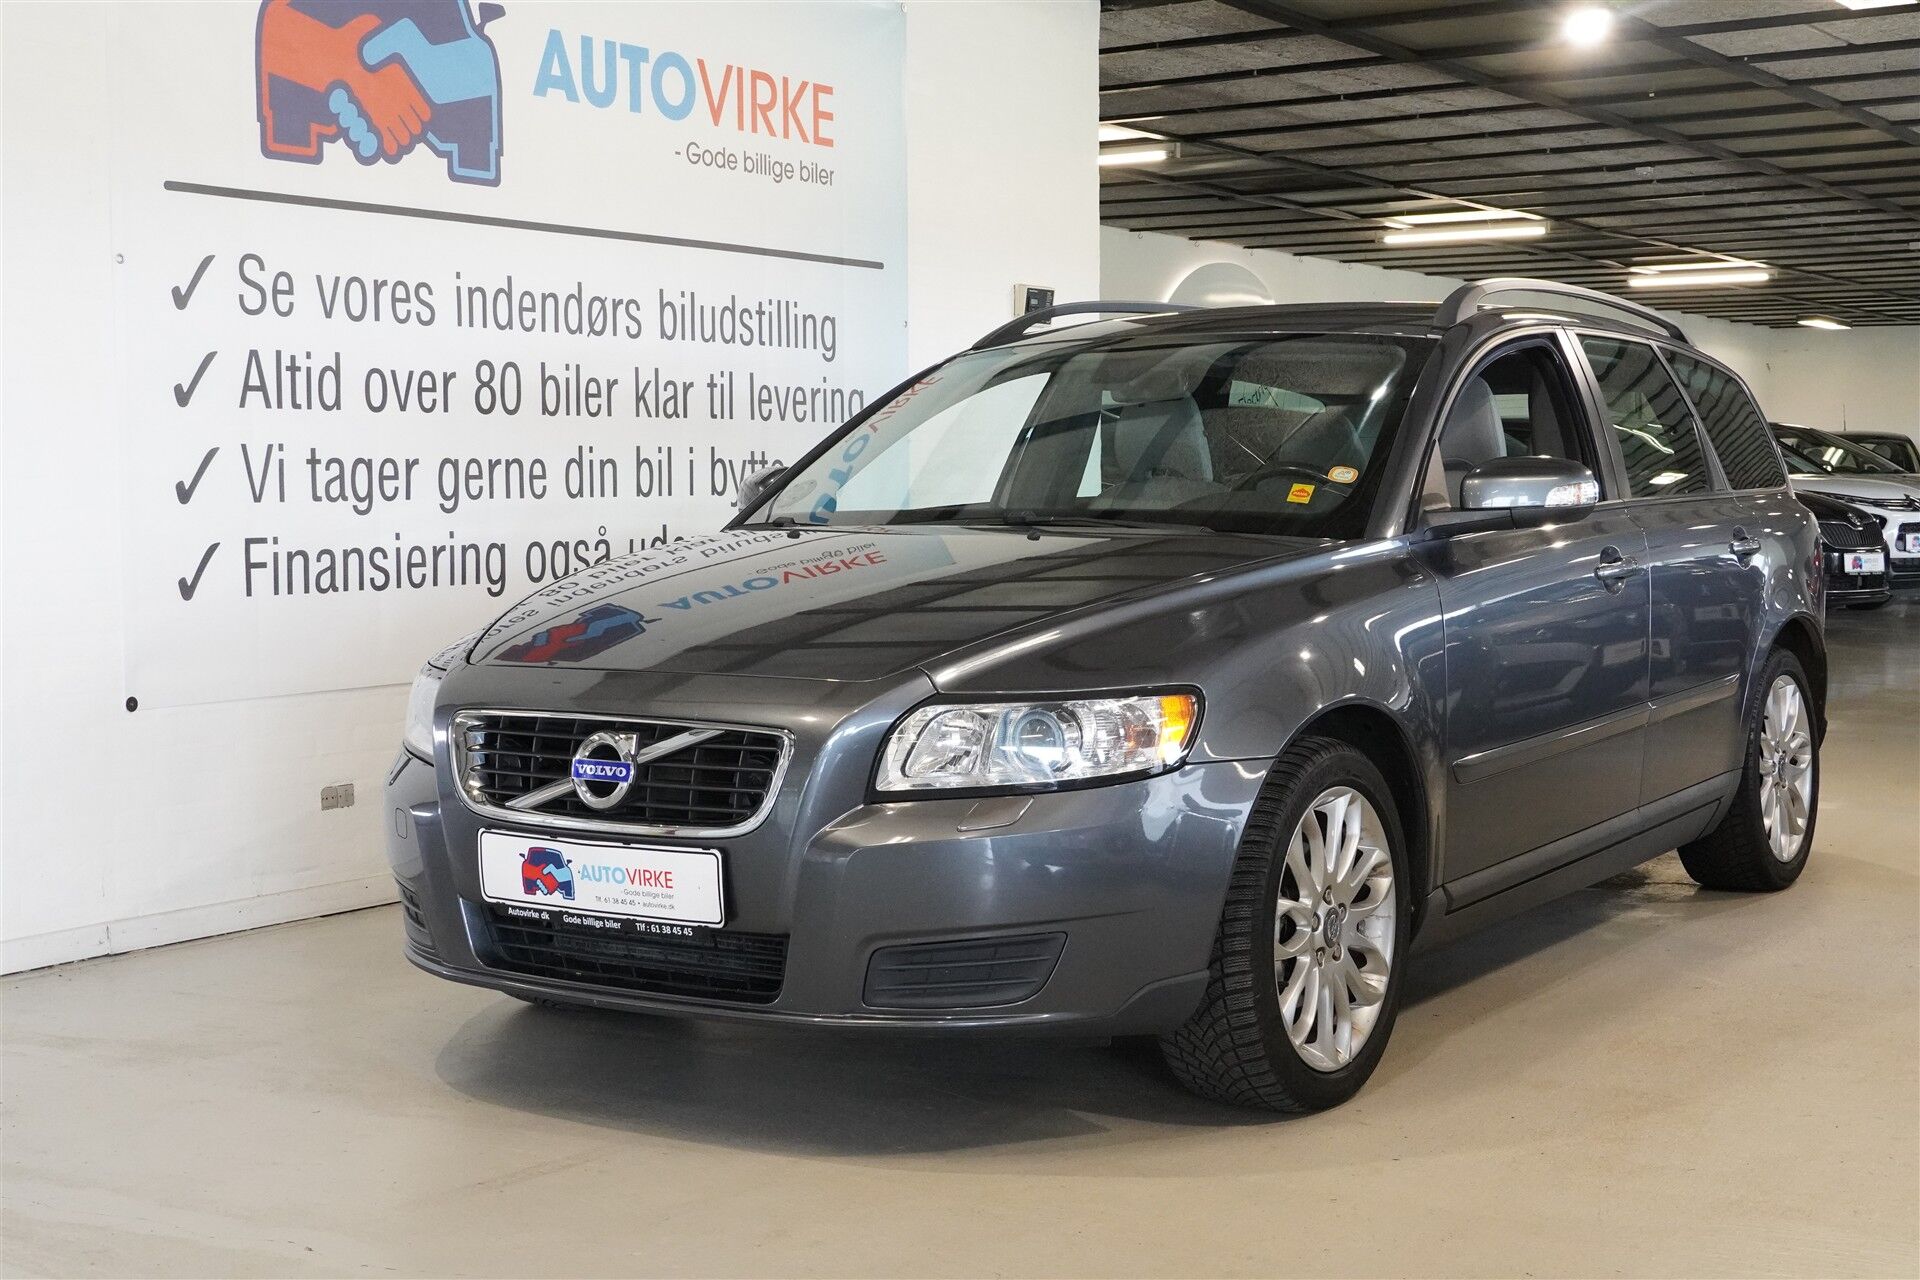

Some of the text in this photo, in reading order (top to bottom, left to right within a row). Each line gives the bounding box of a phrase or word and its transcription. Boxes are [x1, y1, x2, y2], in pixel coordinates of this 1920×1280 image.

[533, 28, 834, 148] AUTOVIRKE
[685, 142, 739, 171] Gode
[743, 150, 796, 184] billige
[799, 159, 835, 186] biler
[239, 253, 837, 364] Se vores indendørs biludstilling
[239, 349, 864, 423] Altid over 80 biler klar til levering
[241, 442, 286, 504] Vi
[306, 447, 420, 516] tager
[438, 457, 548, 516] gerne
[564, 444, 618, 500] din
[636, 445, 673, 498] bil
[688, 446, 695, 497] i
[245, 530, 507, 598] Finansiering
[525, 525, 611, 584] også
[575, 763, 627, 777] VOLVO
[580, 863, 674, 889] AUTOVIRKE
[623, 888, 674, 900] Gode billige biler
[508, 906, 540, 919] Autovirke
[563, 914, 582, 924] Gode
[582, 916, 604, 928] billige
[604, 919, 622, 929] biler
[650, 924, 660, 933] 61
[661, 925, 671, 934] 38
[672, 926, 682, 935] 45
[683, 927, 693, 936] 45
